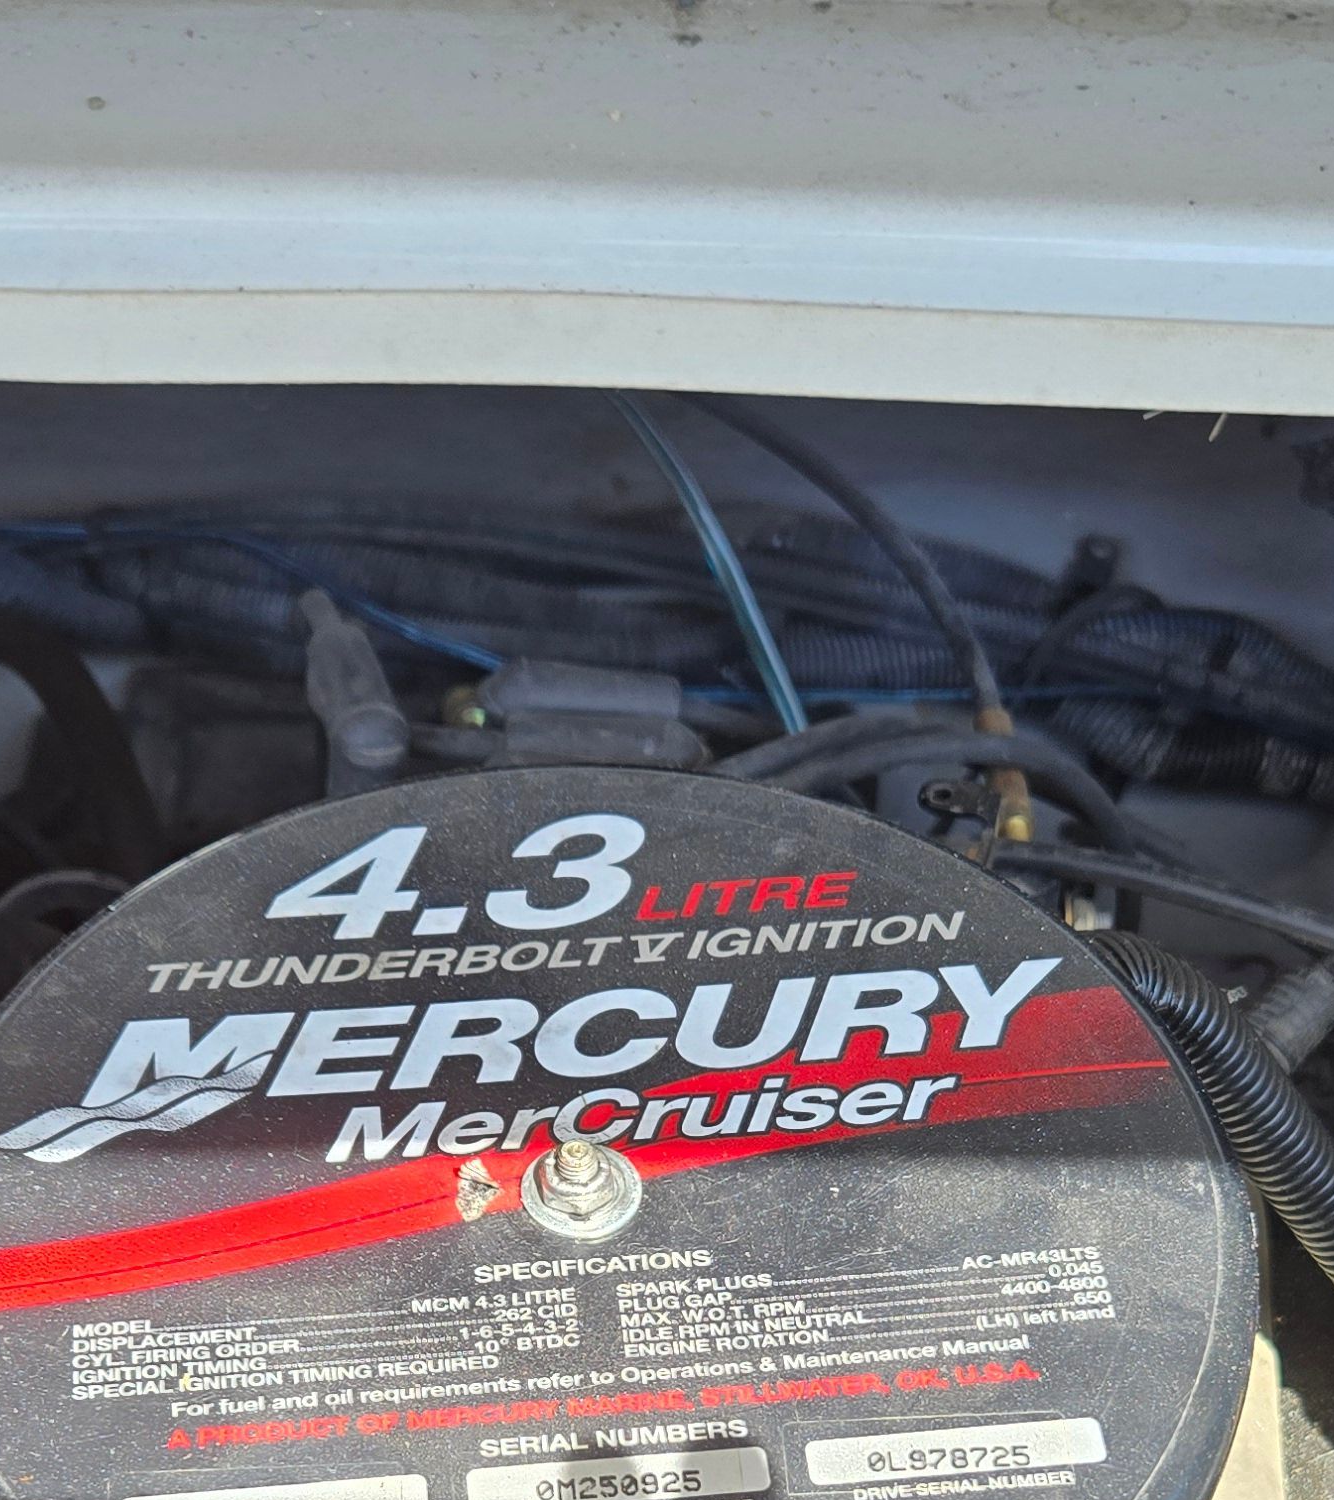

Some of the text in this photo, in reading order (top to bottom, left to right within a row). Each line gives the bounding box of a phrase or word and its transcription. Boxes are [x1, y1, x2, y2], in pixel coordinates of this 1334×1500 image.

[265, 813, 858, 941] 4.3 LITRE
[146, 936, 608, 994] THUNDERBOLT
[686, 911, 966, 960] IGNITION
[324, 1073, 959, 1164] MerCruiser
[474, 1250, 713, 1284] SPECIFICATIONS
[616, 1246, 1101, 1298] SPARK PLUGS AC-MR43LTS
[618, 1260, 1105, 1314] PLUG GAP 0.045
[72, 1287, 575, 1338] MODEL MCM 4.3 LITRE
[622, 1290, 1112, 1343] IDLE RPM IN NEUTRAL 650
[682, 1305, 749, 1325] W.O.T.
[753, 1301, 806, 1318] RPM
[1000, 1275, 1108, 1297] 4400-4800
[72, 1303, 578, 1354] DISPLACEMENT 262 CID
[72, 1318, 579, 1369] CYL. FIRING ORDER 1-6-5-4-3-2
[624, 1302, 1116, 1358] ENGINE ROTATION (LH) left hand
[72, 1362, 175, 1385] IGNITION
[184, 1357, 267, 1377] TIMING
[516, 1333, 580, 1351] BTDC
[72, 1354, 499, 1400] SPECIAL IGNITION TIMING REQUIRED
[171, 1334, 1030, 1417] For fuel and oil requirements refer to Operations & Maintenance Manual
[168, 1427, 191, 1450] A
[196, 1415, 350, 1447] PRODUCT
[356, 1410, 400, 1433] OF
[406, 1399, 560, 1430] MERCURY
[954, 1359, 1041, 1386] U.S.A.
[479, 1419, 749, 1458] SERIAL NUMBERS
[866, 1444, 1032, 1473] 0L978725
[853, 1470, 1075, 1500] DRIVE SERIAL NUMBER
